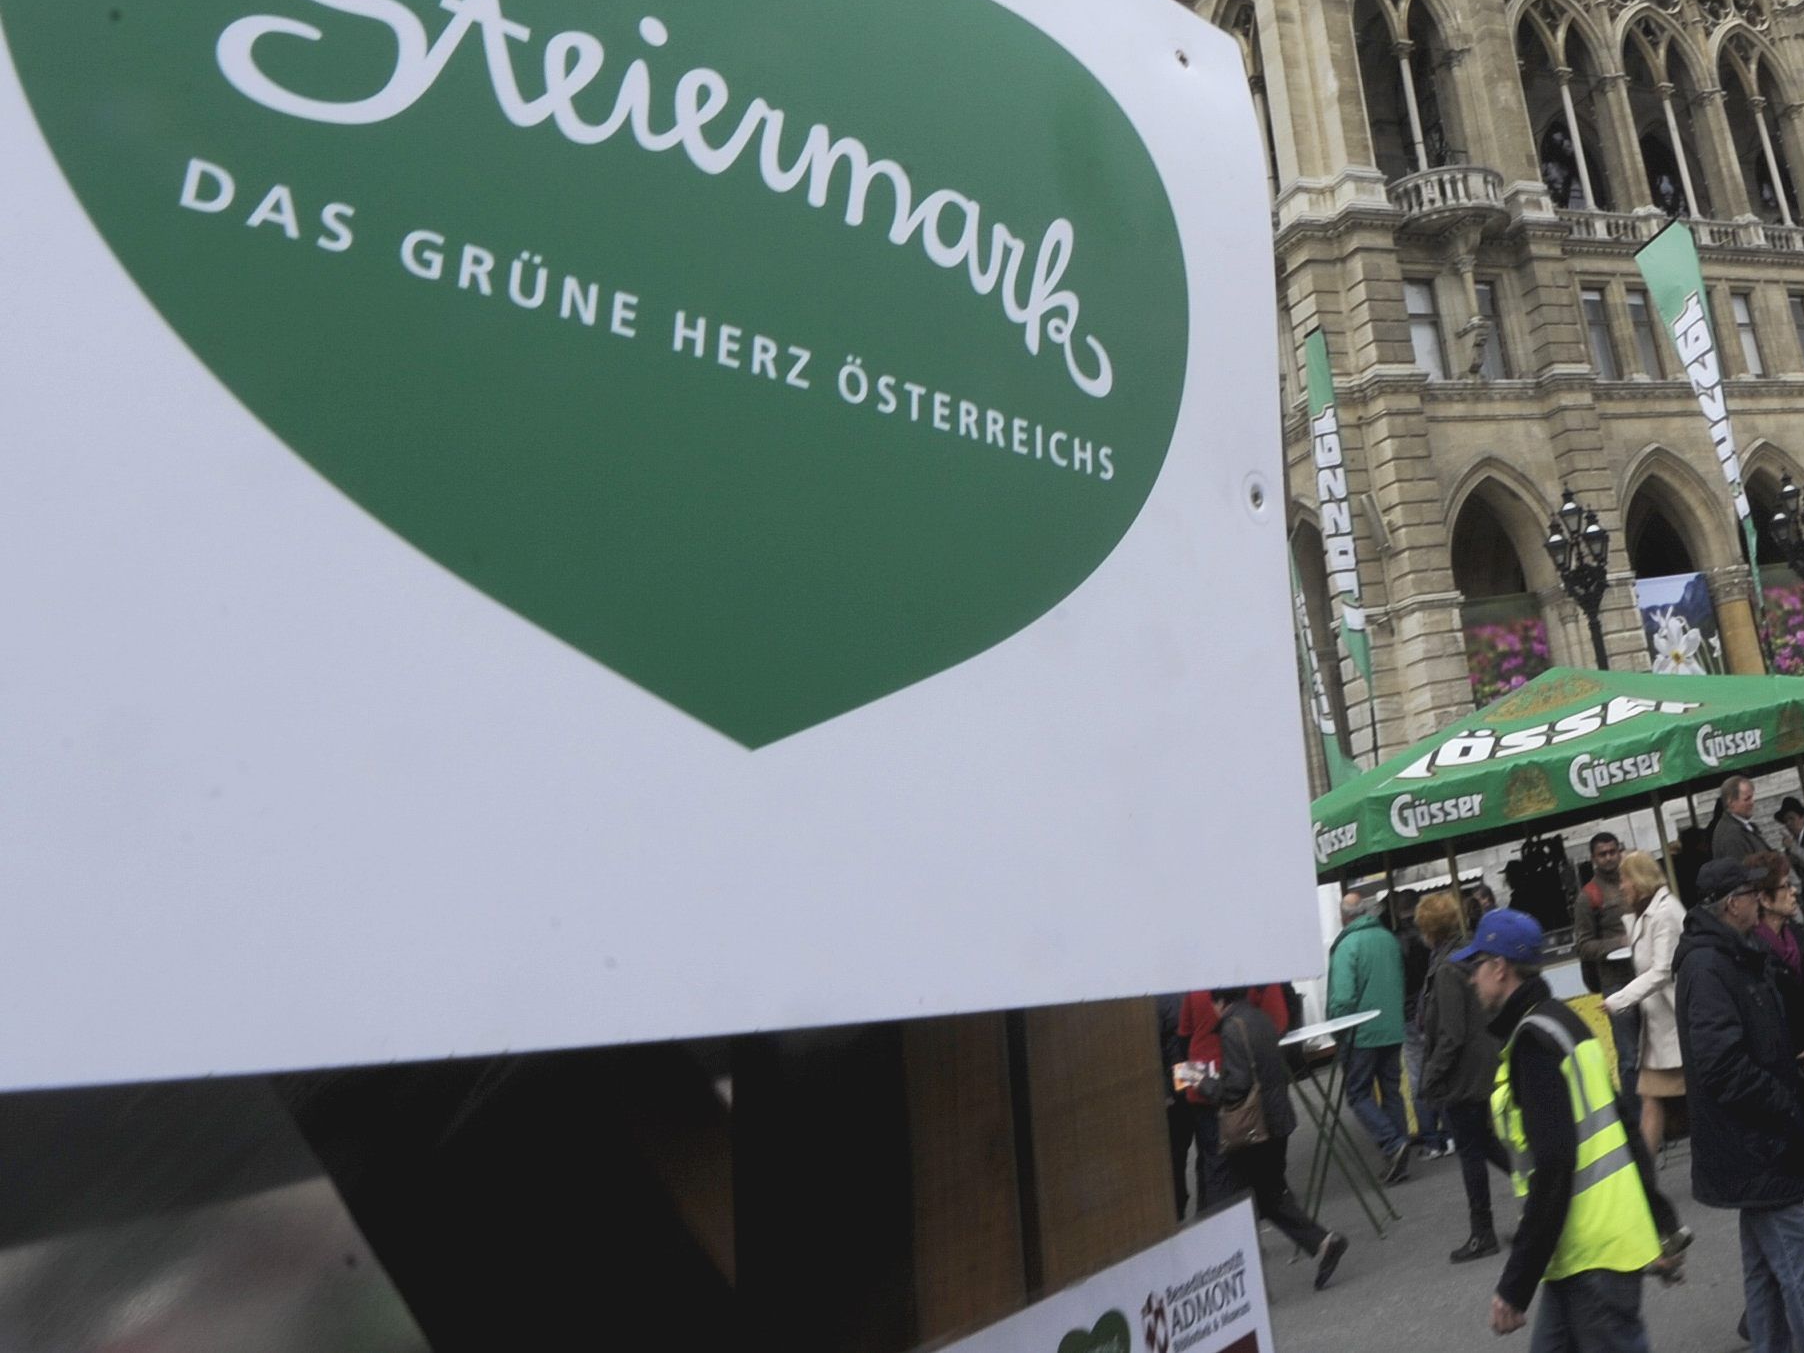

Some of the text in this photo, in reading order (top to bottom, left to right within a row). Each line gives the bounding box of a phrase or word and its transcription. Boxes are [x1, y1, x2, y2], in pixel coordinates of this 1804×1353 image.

[182, 160, 1113, 479] DAS GRÜNE HERZ ÖSTERREICHS
[1696, 724, 1762, 767] Gösser
[1569, 753, 1663, 797] Gösser
[1391, 794, 1483, 838] Gösser
[1312, 821, 1358, 864] Gösser
[1171, 1268, 1245, 1337] ADMONT
